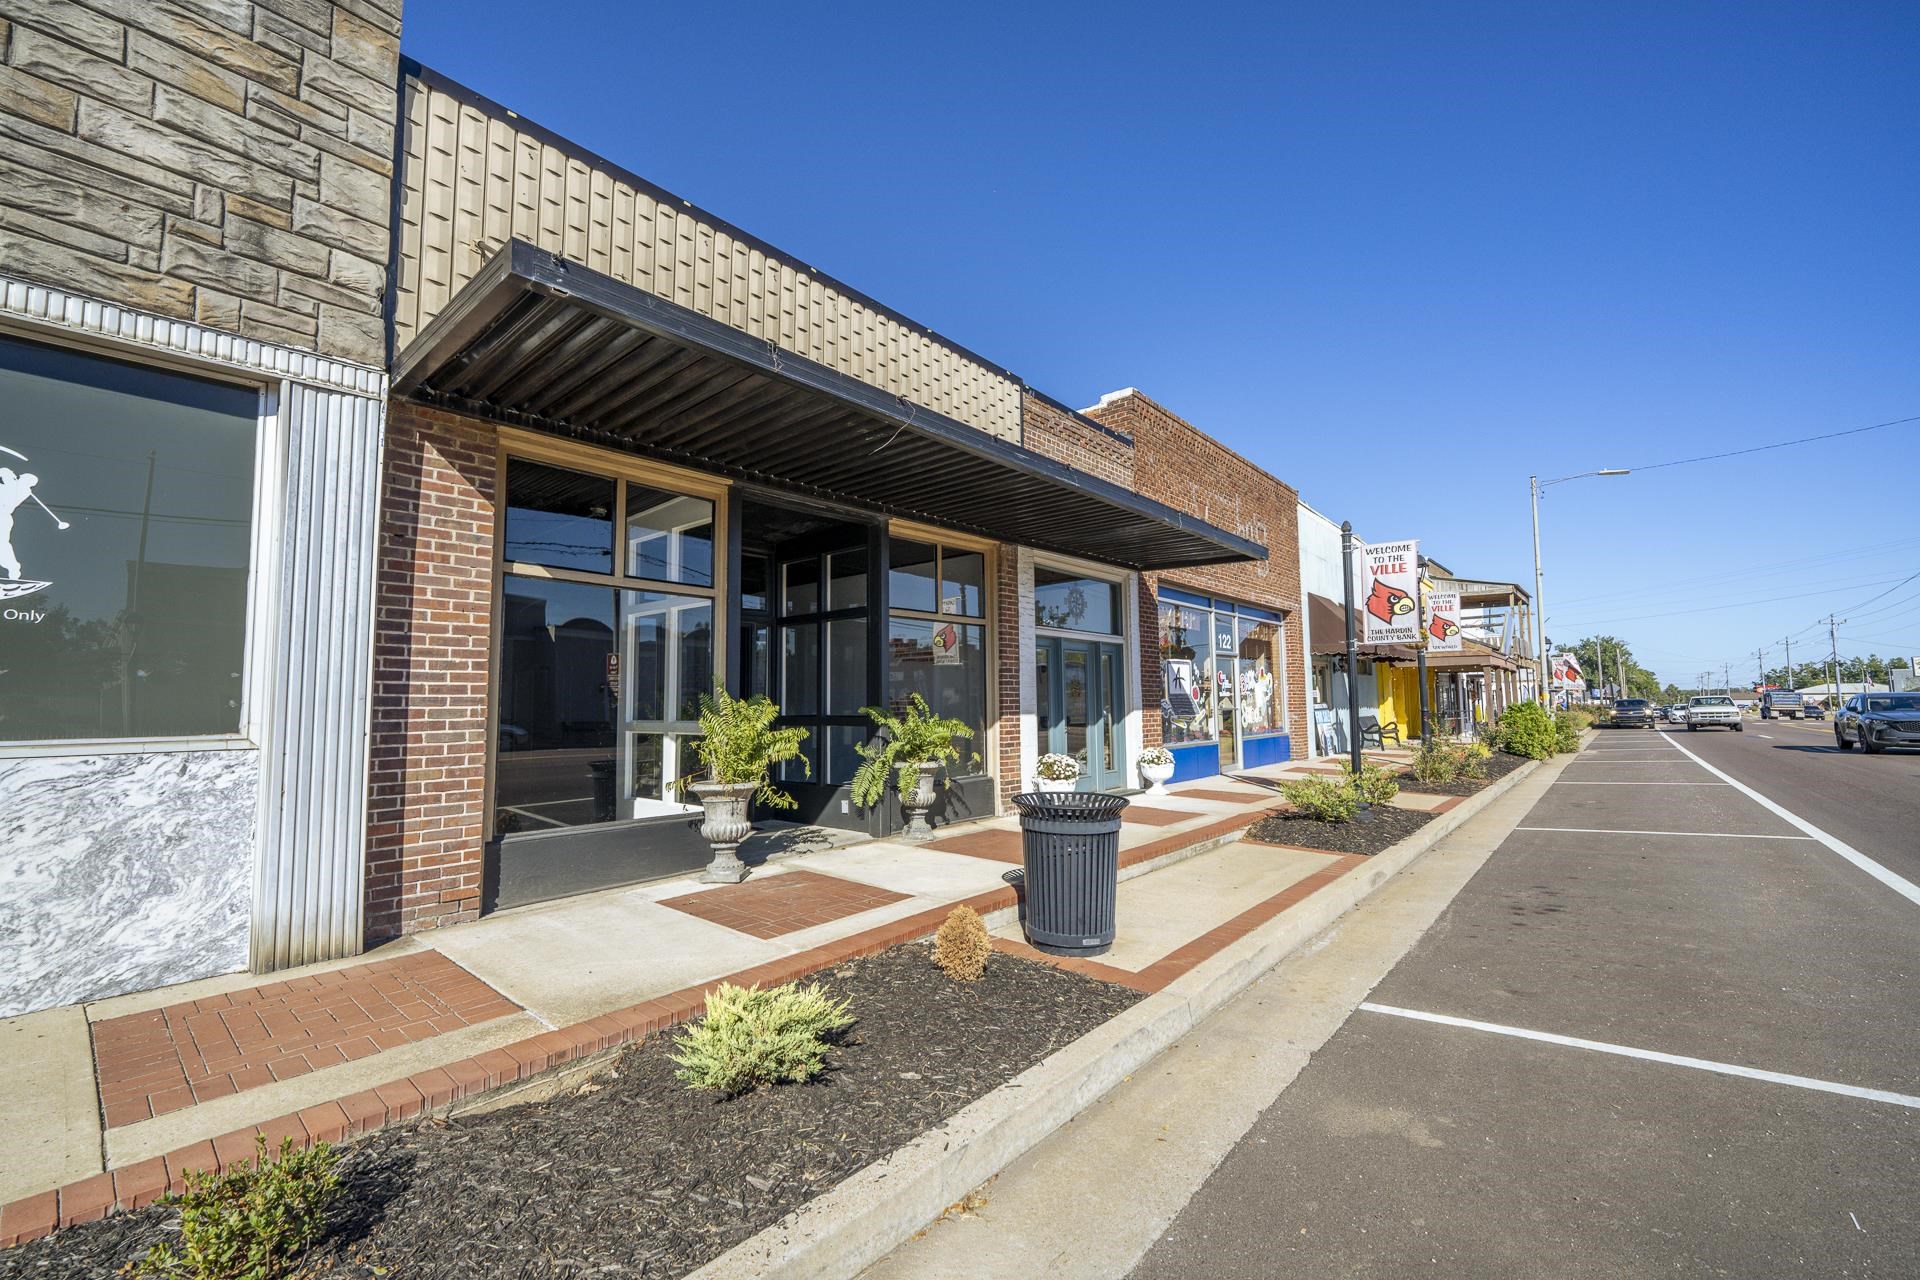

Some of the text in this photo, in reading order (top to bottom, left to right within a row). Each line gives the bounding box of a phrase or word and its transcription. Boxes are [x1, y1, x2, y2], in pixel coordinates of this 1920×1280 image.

[1365, 544, 1412, 556] WELCOME
[1374, 554, 1405, 564] TO THE
[1370, 562, 1408, 576] VILLE
[1431, 604, 1455, 612] VILLE
[3, 608, 46, 624] Only
[1385, 627, 1413, 635] HARDIN
[1218, 633, 1232, 649] 122
[1367, 634, 1395, 642] COUNTY
